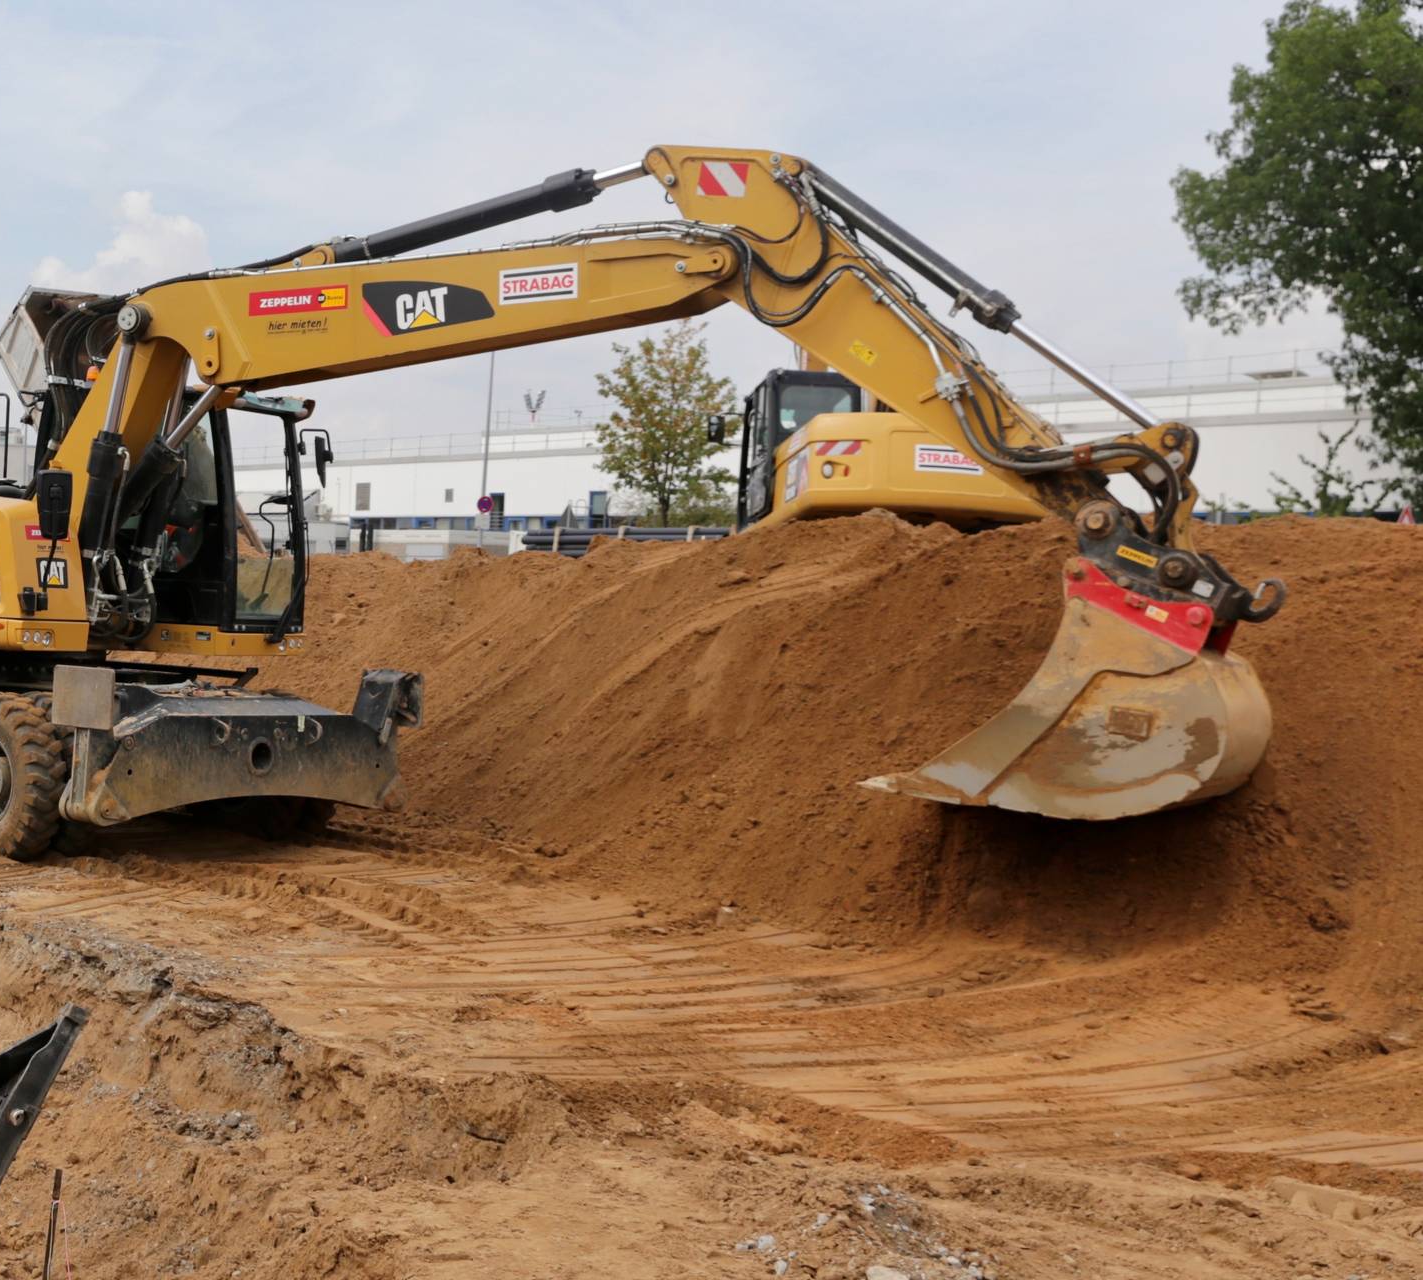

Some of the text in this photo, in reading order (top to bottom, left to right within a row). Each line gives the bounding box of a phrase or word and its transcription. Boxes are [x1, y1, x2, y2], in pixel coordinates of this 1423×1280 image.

[503, 274, 574, 295] STRABAG
[259, 295, 312, 309] ZEPPELIN
[395, 286, 448, 330] CAT
[268, 321, 287, 331] hier
[918, 452, 978, 467] STRABA
